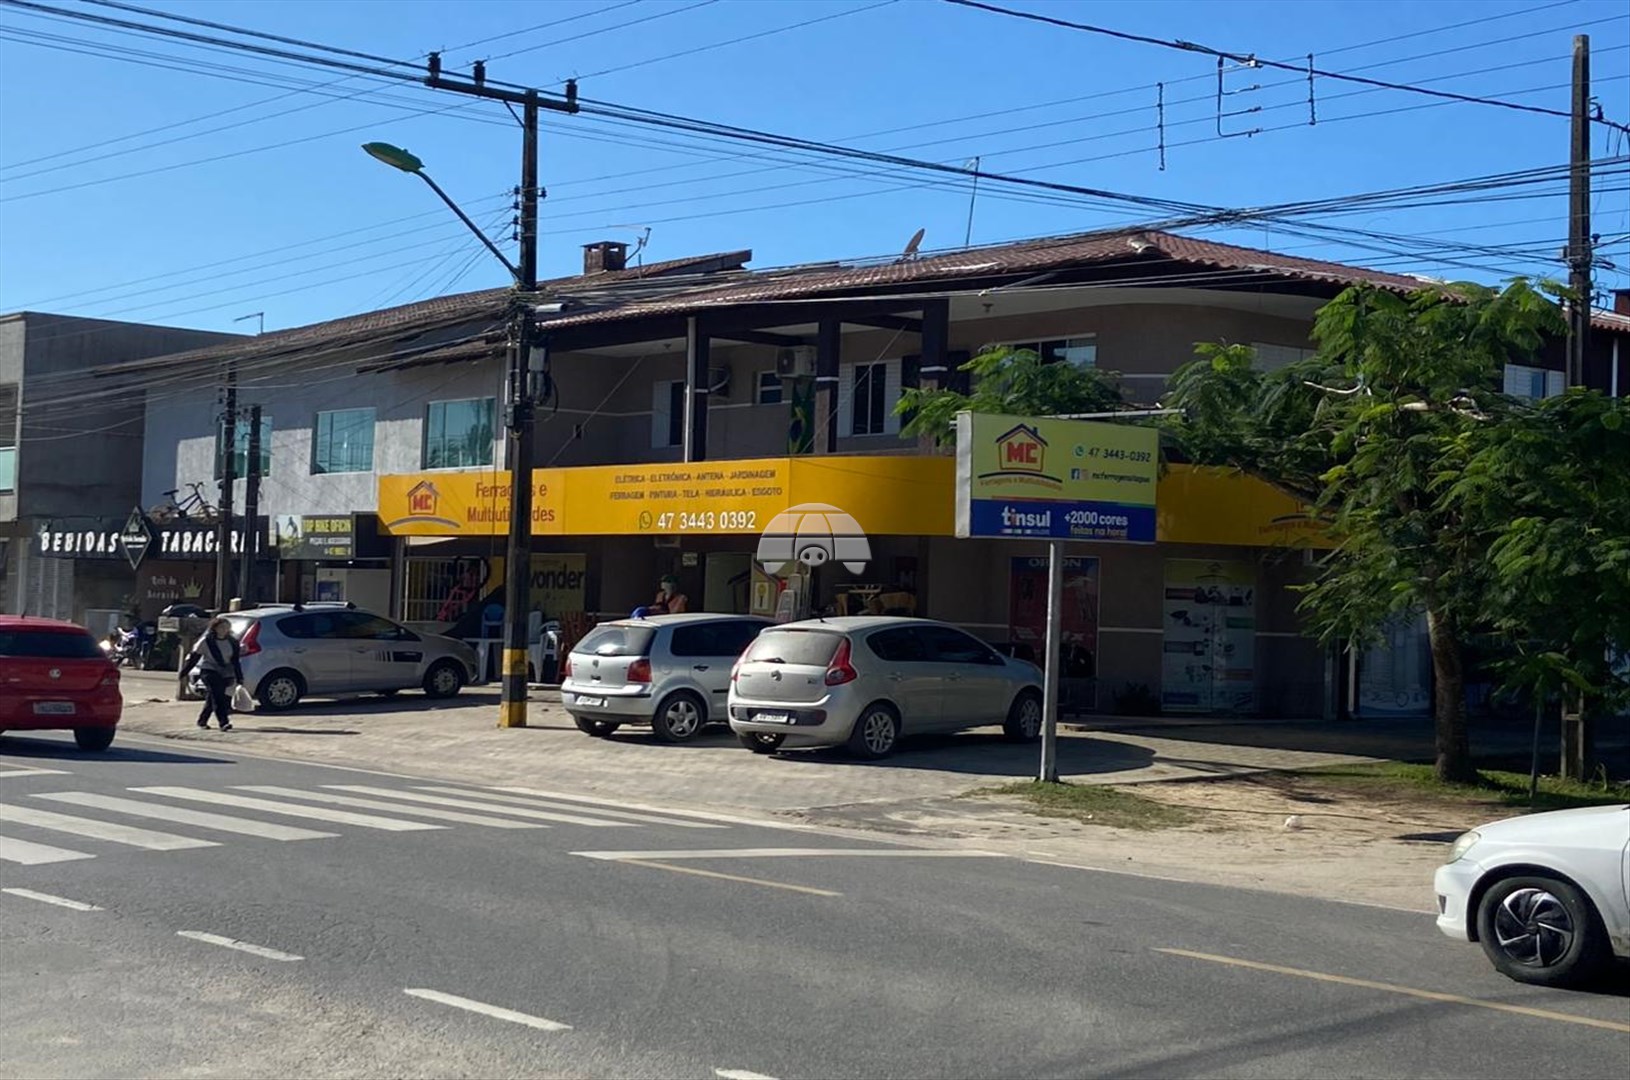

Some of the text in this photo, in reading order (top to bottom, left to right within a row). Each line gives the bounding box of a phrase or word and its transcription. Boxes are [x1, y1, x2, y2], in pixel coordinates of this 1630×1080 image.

[1006, 442, 1038, 464] MC
[1088, 447, 1151, 462] 47 3443-0392
[696, 472, 724, 481] ANTENA
[730, 469, 776, 479] JARDINAGEM
[539, 483, 548, 497] e
[682, 489, 699, 498] TELA
[752, 487, 783, 496] ESGOTO
[412, 493, 433, 511] MC
[657, 510, 756, 530] 47 3443 0392
[1001, 505, 1051, 528] tinsul
[1064, 510, 1129, 526] +2000 cores
[41, 531, 119, 553] BEBIDAS
